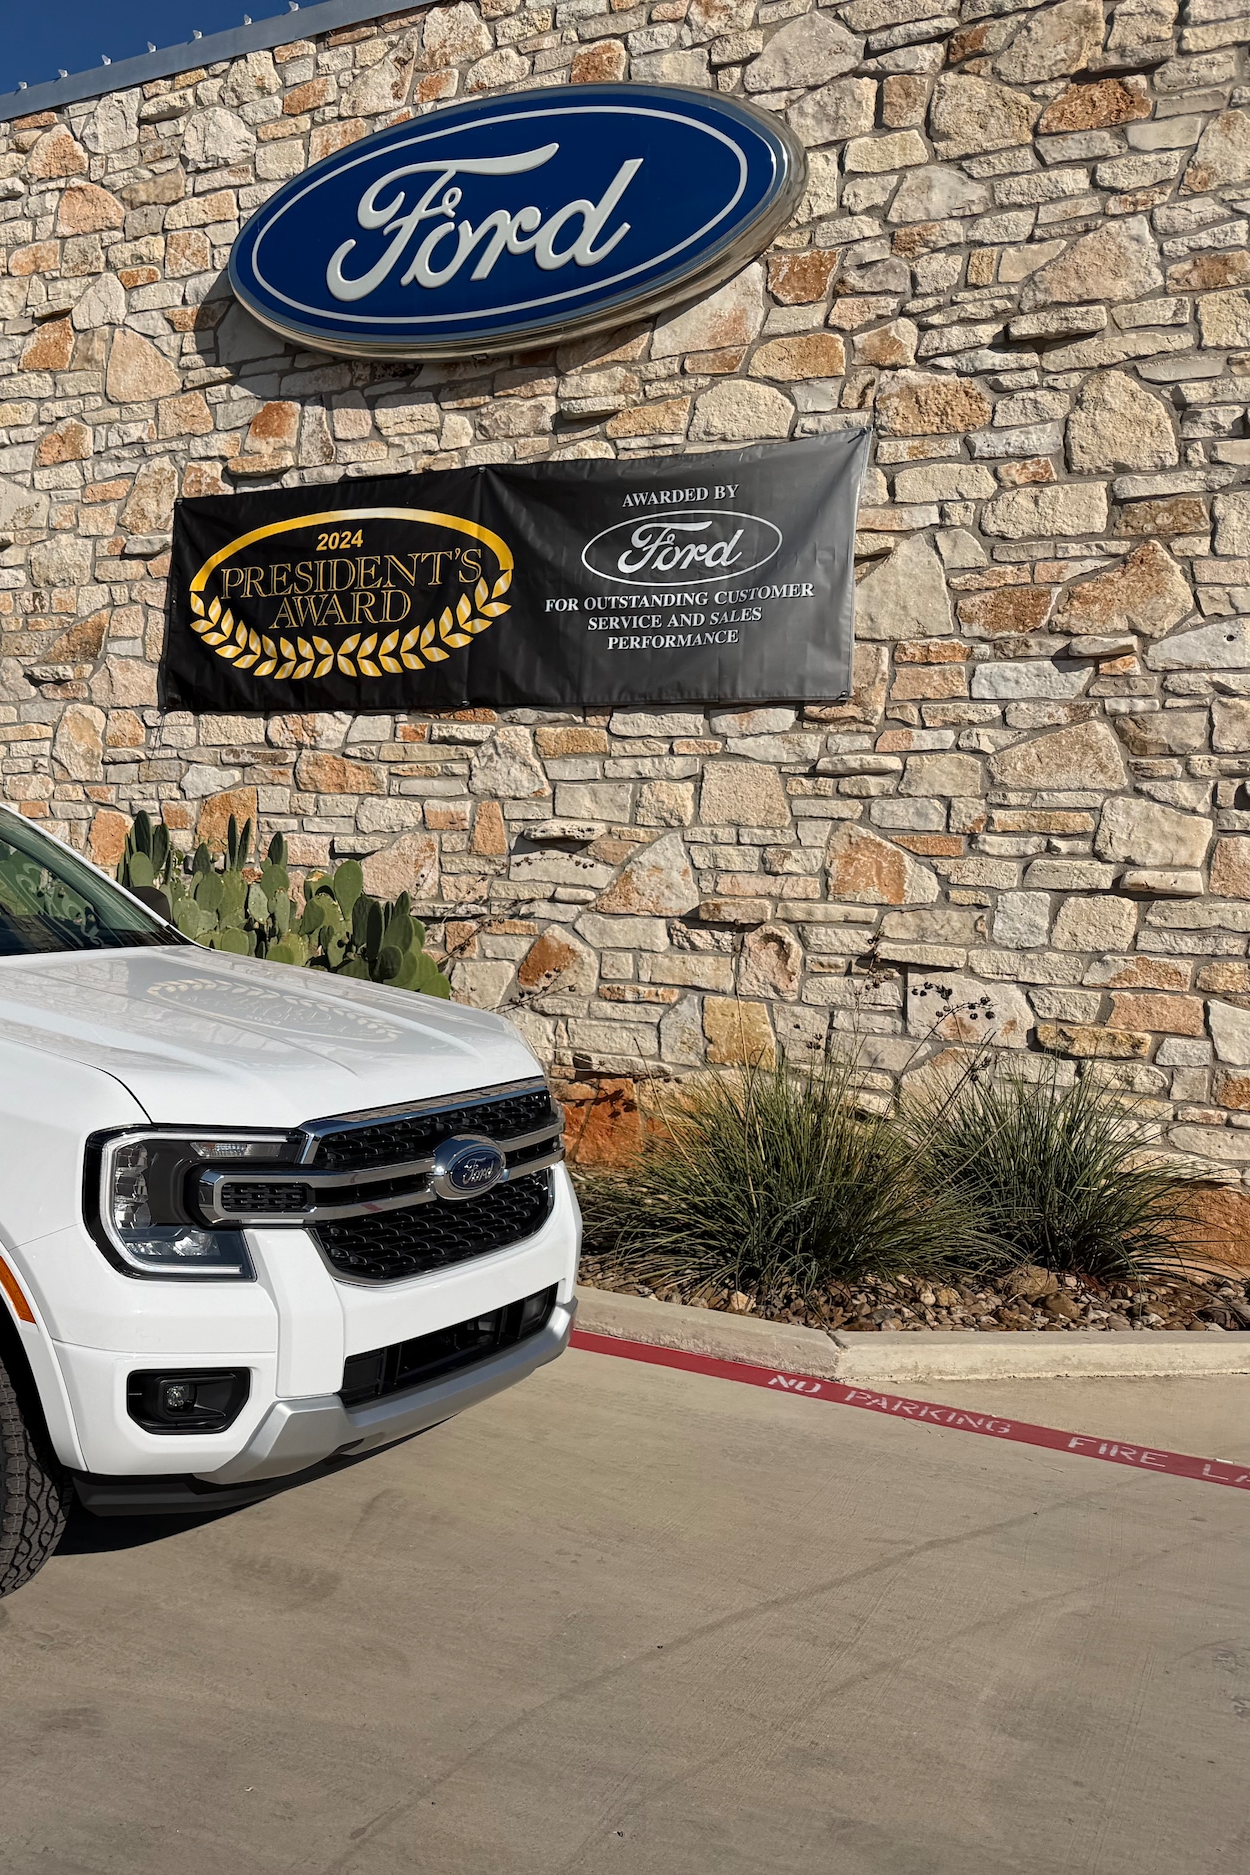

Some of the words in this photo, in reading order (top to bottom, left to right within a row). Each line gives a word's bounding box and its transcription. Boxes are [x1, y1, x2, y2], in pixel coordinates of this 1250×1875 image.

[326, 142, 644, 301] Ford
[622, 486, 709, 507] AWARDED
[714, 484, 739, 499] BY
[316, 529, 364, 551] 2024
[617, 520, 745, 574] Ford
[220, 548, 482, 600] PRESIDENT'S
[268, 589, 412, 629] AWARD
[545, 597, 579, 612] FOR
[583, 592, 709, 611] OUTSTANDING
[714, 582, 815, 605] CUSTOMER
[587, 614, 662, 631] SERVICE
[666, 611, 706, 628] AND
[709, 606, 763, 625] SALES
[607, 629, 739, 650] PERFORMANCE
[462, 1156, 495, 1185] Ford
[768, 1374, 822, 1394] NO
[845, 1390, 1012, 1434] PARKING
[1067, 1436, 1169, 1469] FIRE
